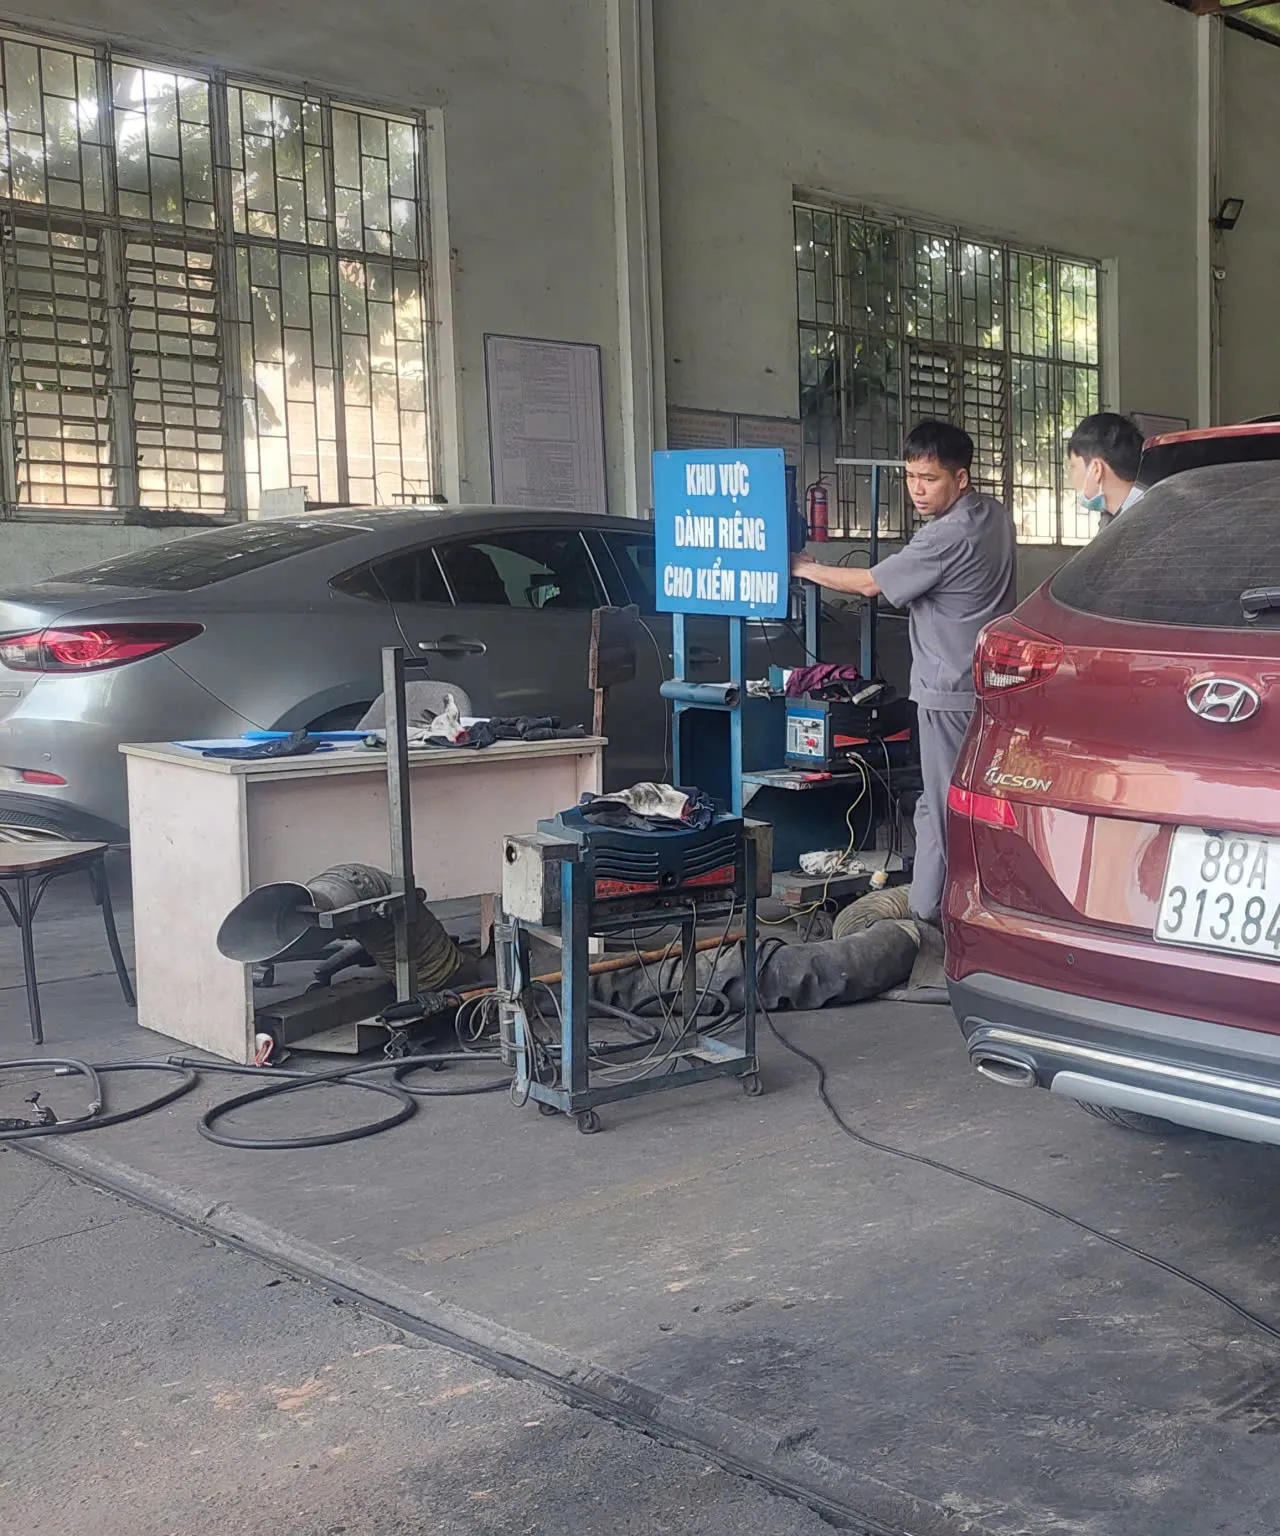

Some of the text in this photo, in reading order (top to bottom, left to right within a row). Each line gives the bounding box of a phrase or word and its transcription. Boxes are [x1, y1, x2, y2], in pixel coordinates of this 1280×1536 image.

[686, 461, 749, 503] KHU VỰC
[675, 509, 766, 551] DÀNH RIÊNG
[664, 557, 778, 608] CHO KIỂM ĐỊNH
[984, 766, 1052, 792] TUCSON
[1200, 837, 1269, 890] 88A
